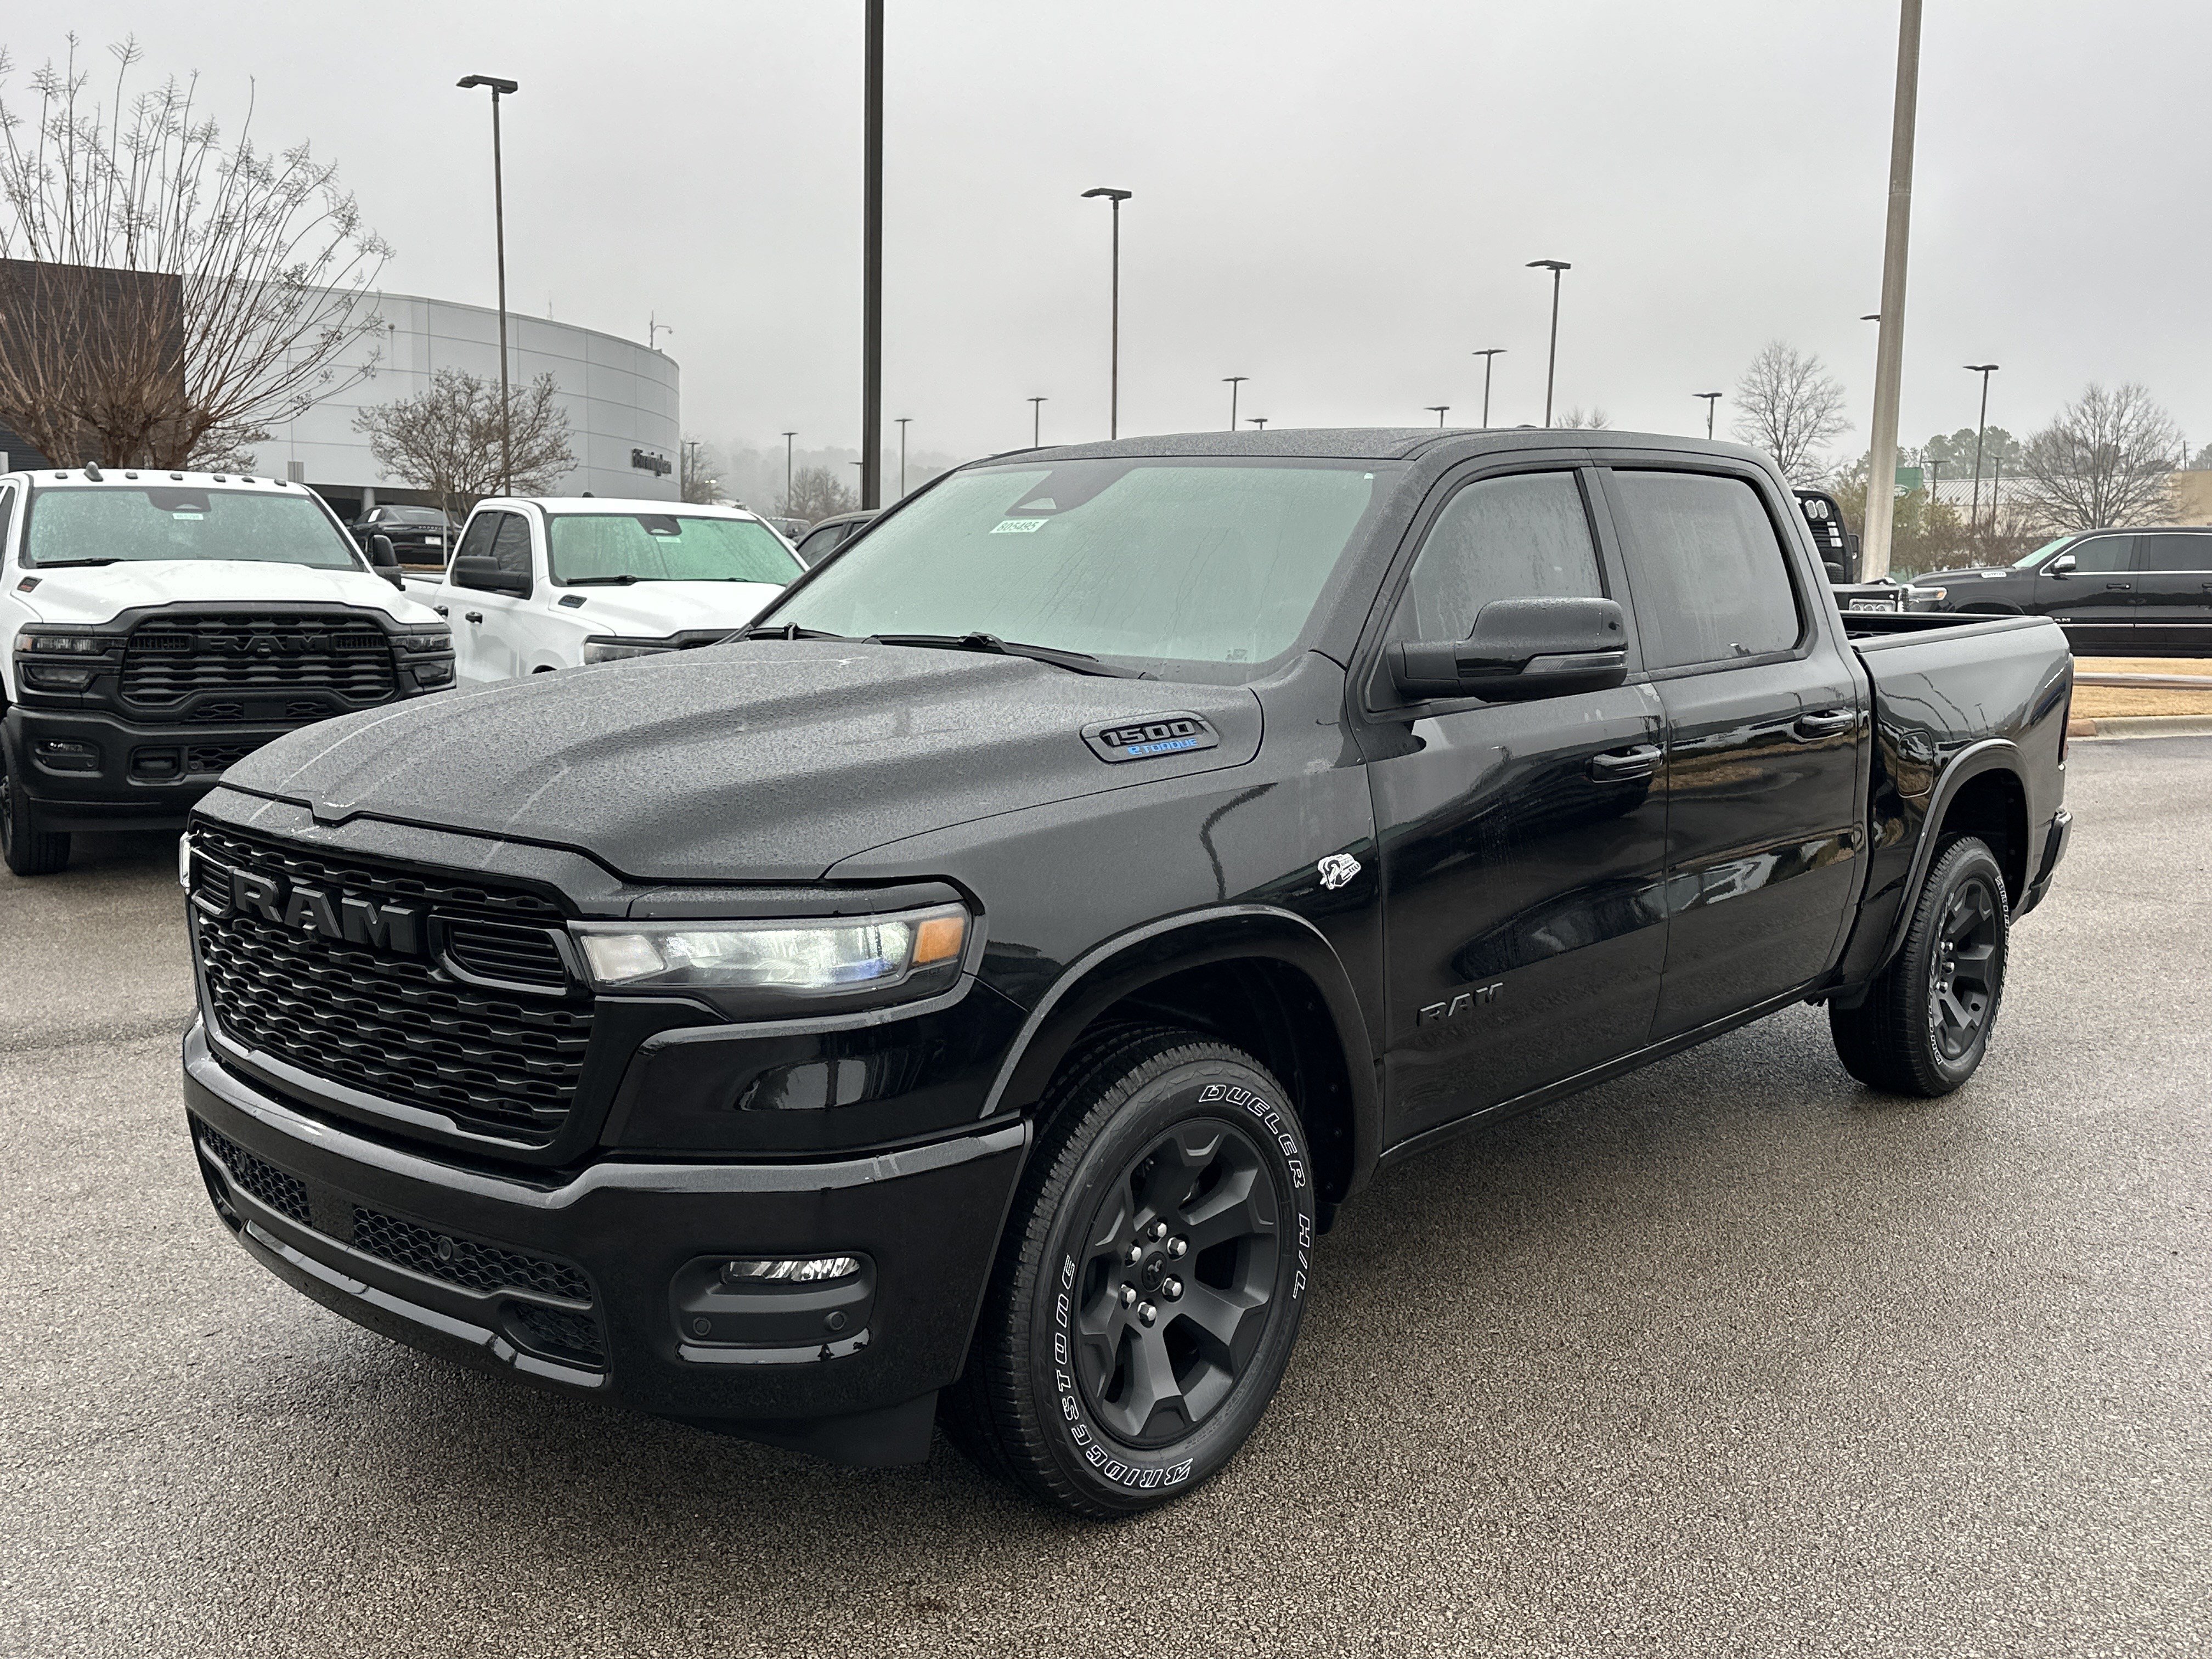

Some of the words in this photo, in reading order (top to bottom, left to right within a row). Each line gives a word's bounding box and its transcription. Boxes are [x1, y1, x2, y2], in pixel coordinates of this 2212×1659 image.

[996, 521, 1040, 532] 805495
[198, 635, 328, 652] RAM
[1102, 720, 1196, 747] 1500
[233, 868, 416, 955] RAM
[1417, 981, 1503, 1027] RAM
[1198, 1084, 1306, 1189] DUELER
[1293, 1212, 1310, 1300] H/L
[1054, 1253, 1194, 1489] BRIDGESTONE
